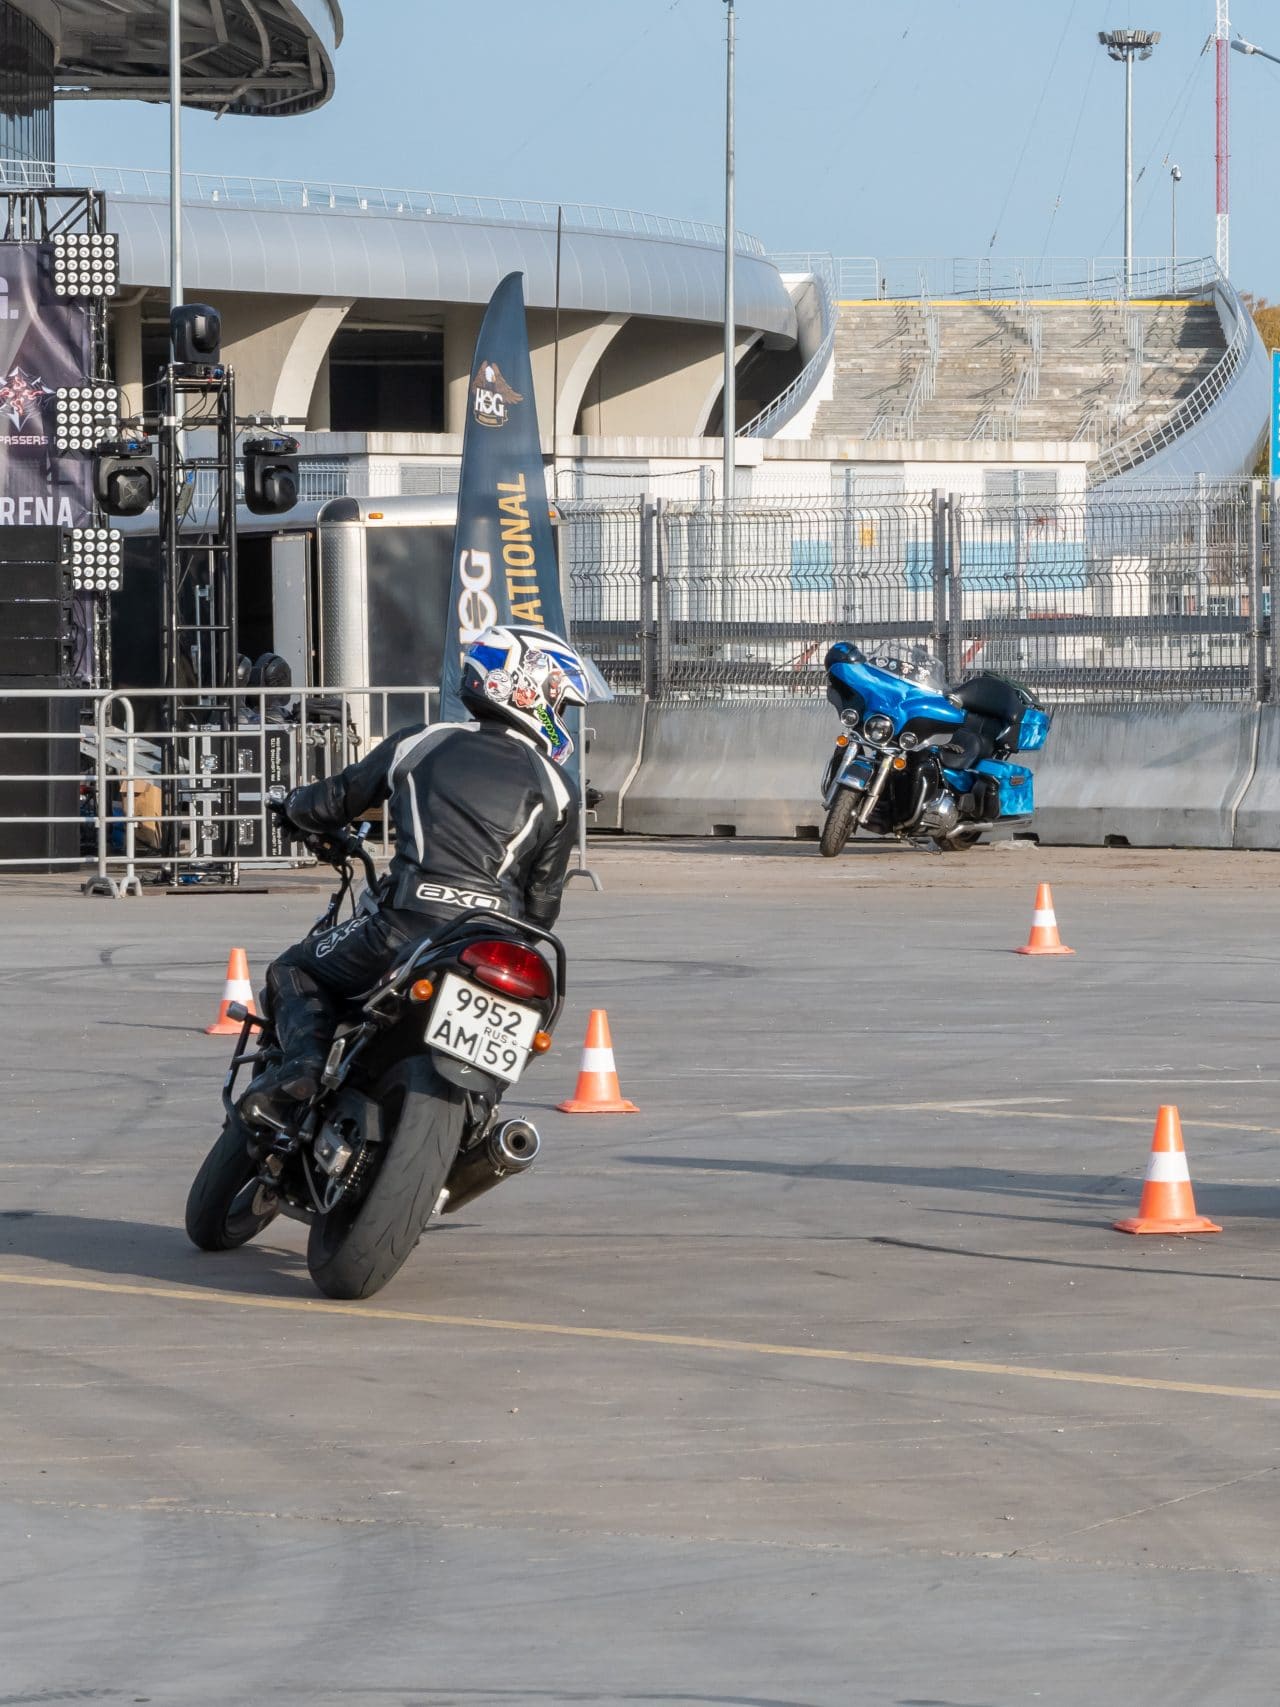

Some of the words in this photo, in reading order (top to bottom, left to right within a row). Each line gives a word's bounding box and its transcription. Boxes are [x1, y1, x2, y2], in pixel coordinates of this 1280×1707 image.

[475, 387, 505, 418] HOG
[496, 473, 545, 630] ATIONAL
[456, 987, 522, 1038] 9952
[483, 1026, 508, 1045] RUS
[482, 1040, 518, 1072] 59
